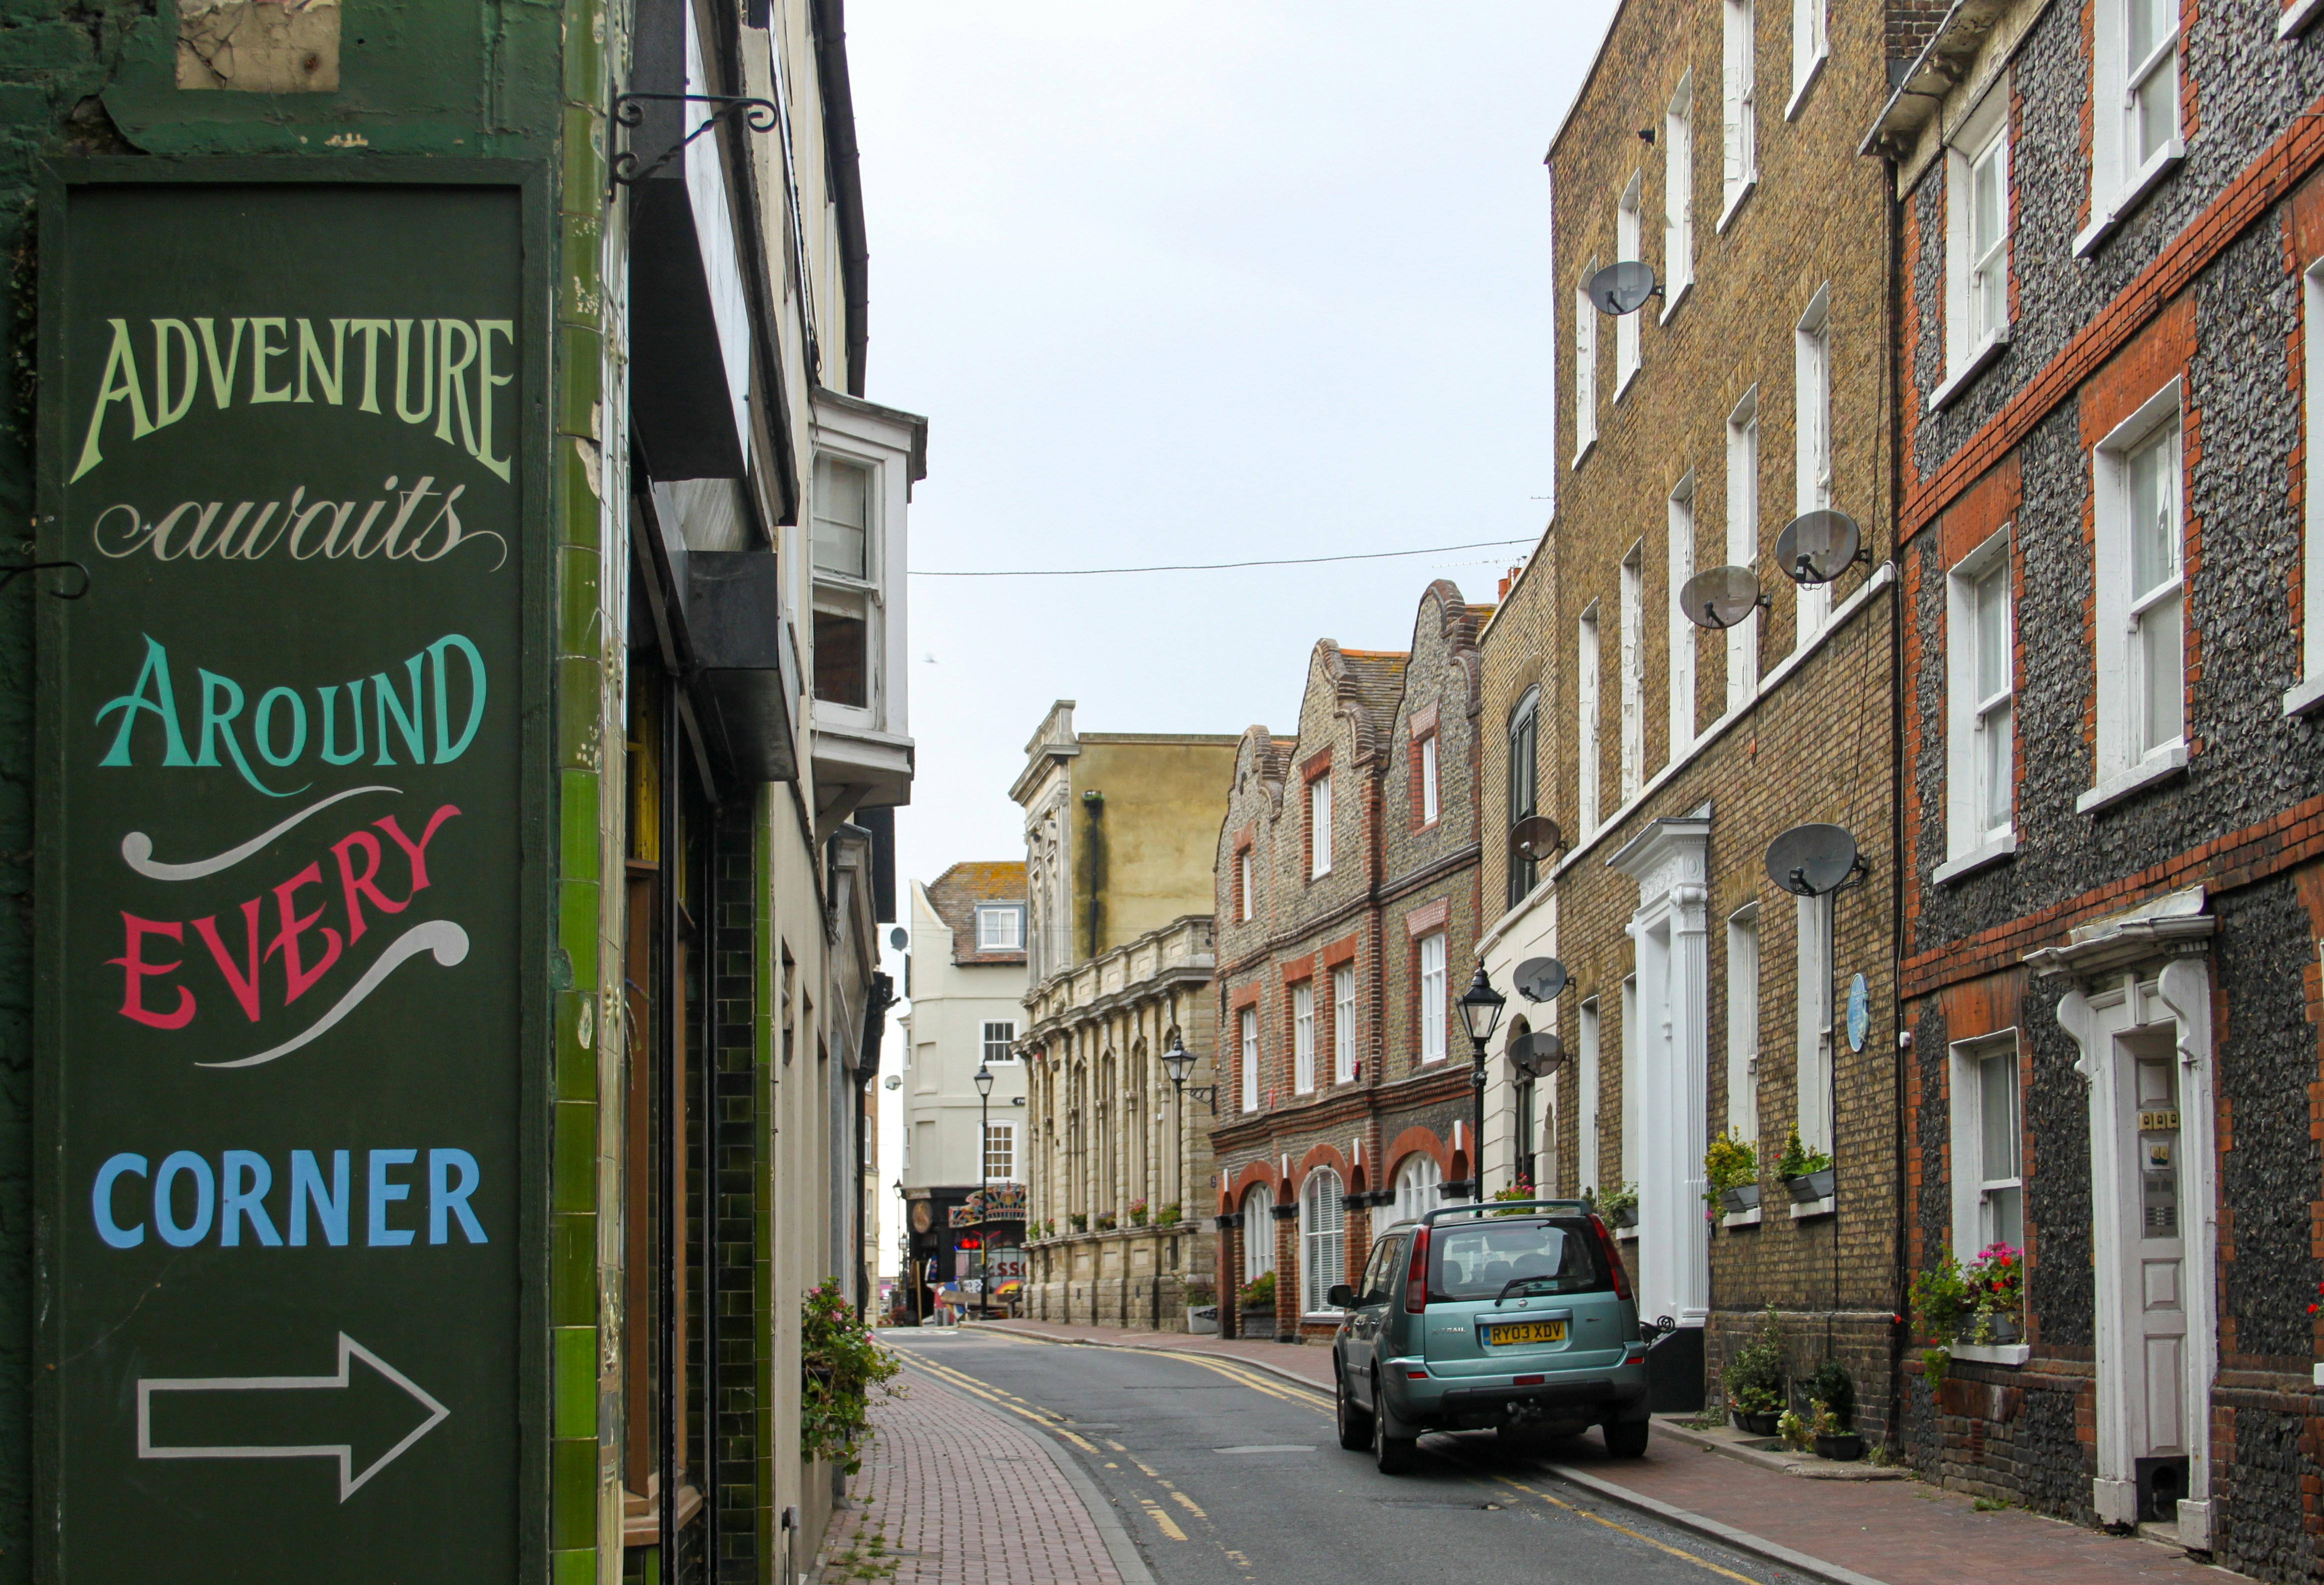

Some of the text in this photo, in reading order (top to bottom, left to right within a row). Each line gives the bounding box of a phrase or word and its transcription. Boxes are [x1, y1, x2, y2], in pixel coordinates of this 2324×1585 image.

[70, 317, 514, 484] ADVENTURE
[94, 475, 507, 572] awaits
[96, 632, 487, 797] AROUND
[103, 804, 462, 1030] EVERY
[93, 1148, 489, 1249] CORNER
[1432, 1327, 1467, 1335] X-TRAIL
[1492, 1323, 1561, 1341] RY03 XDV
